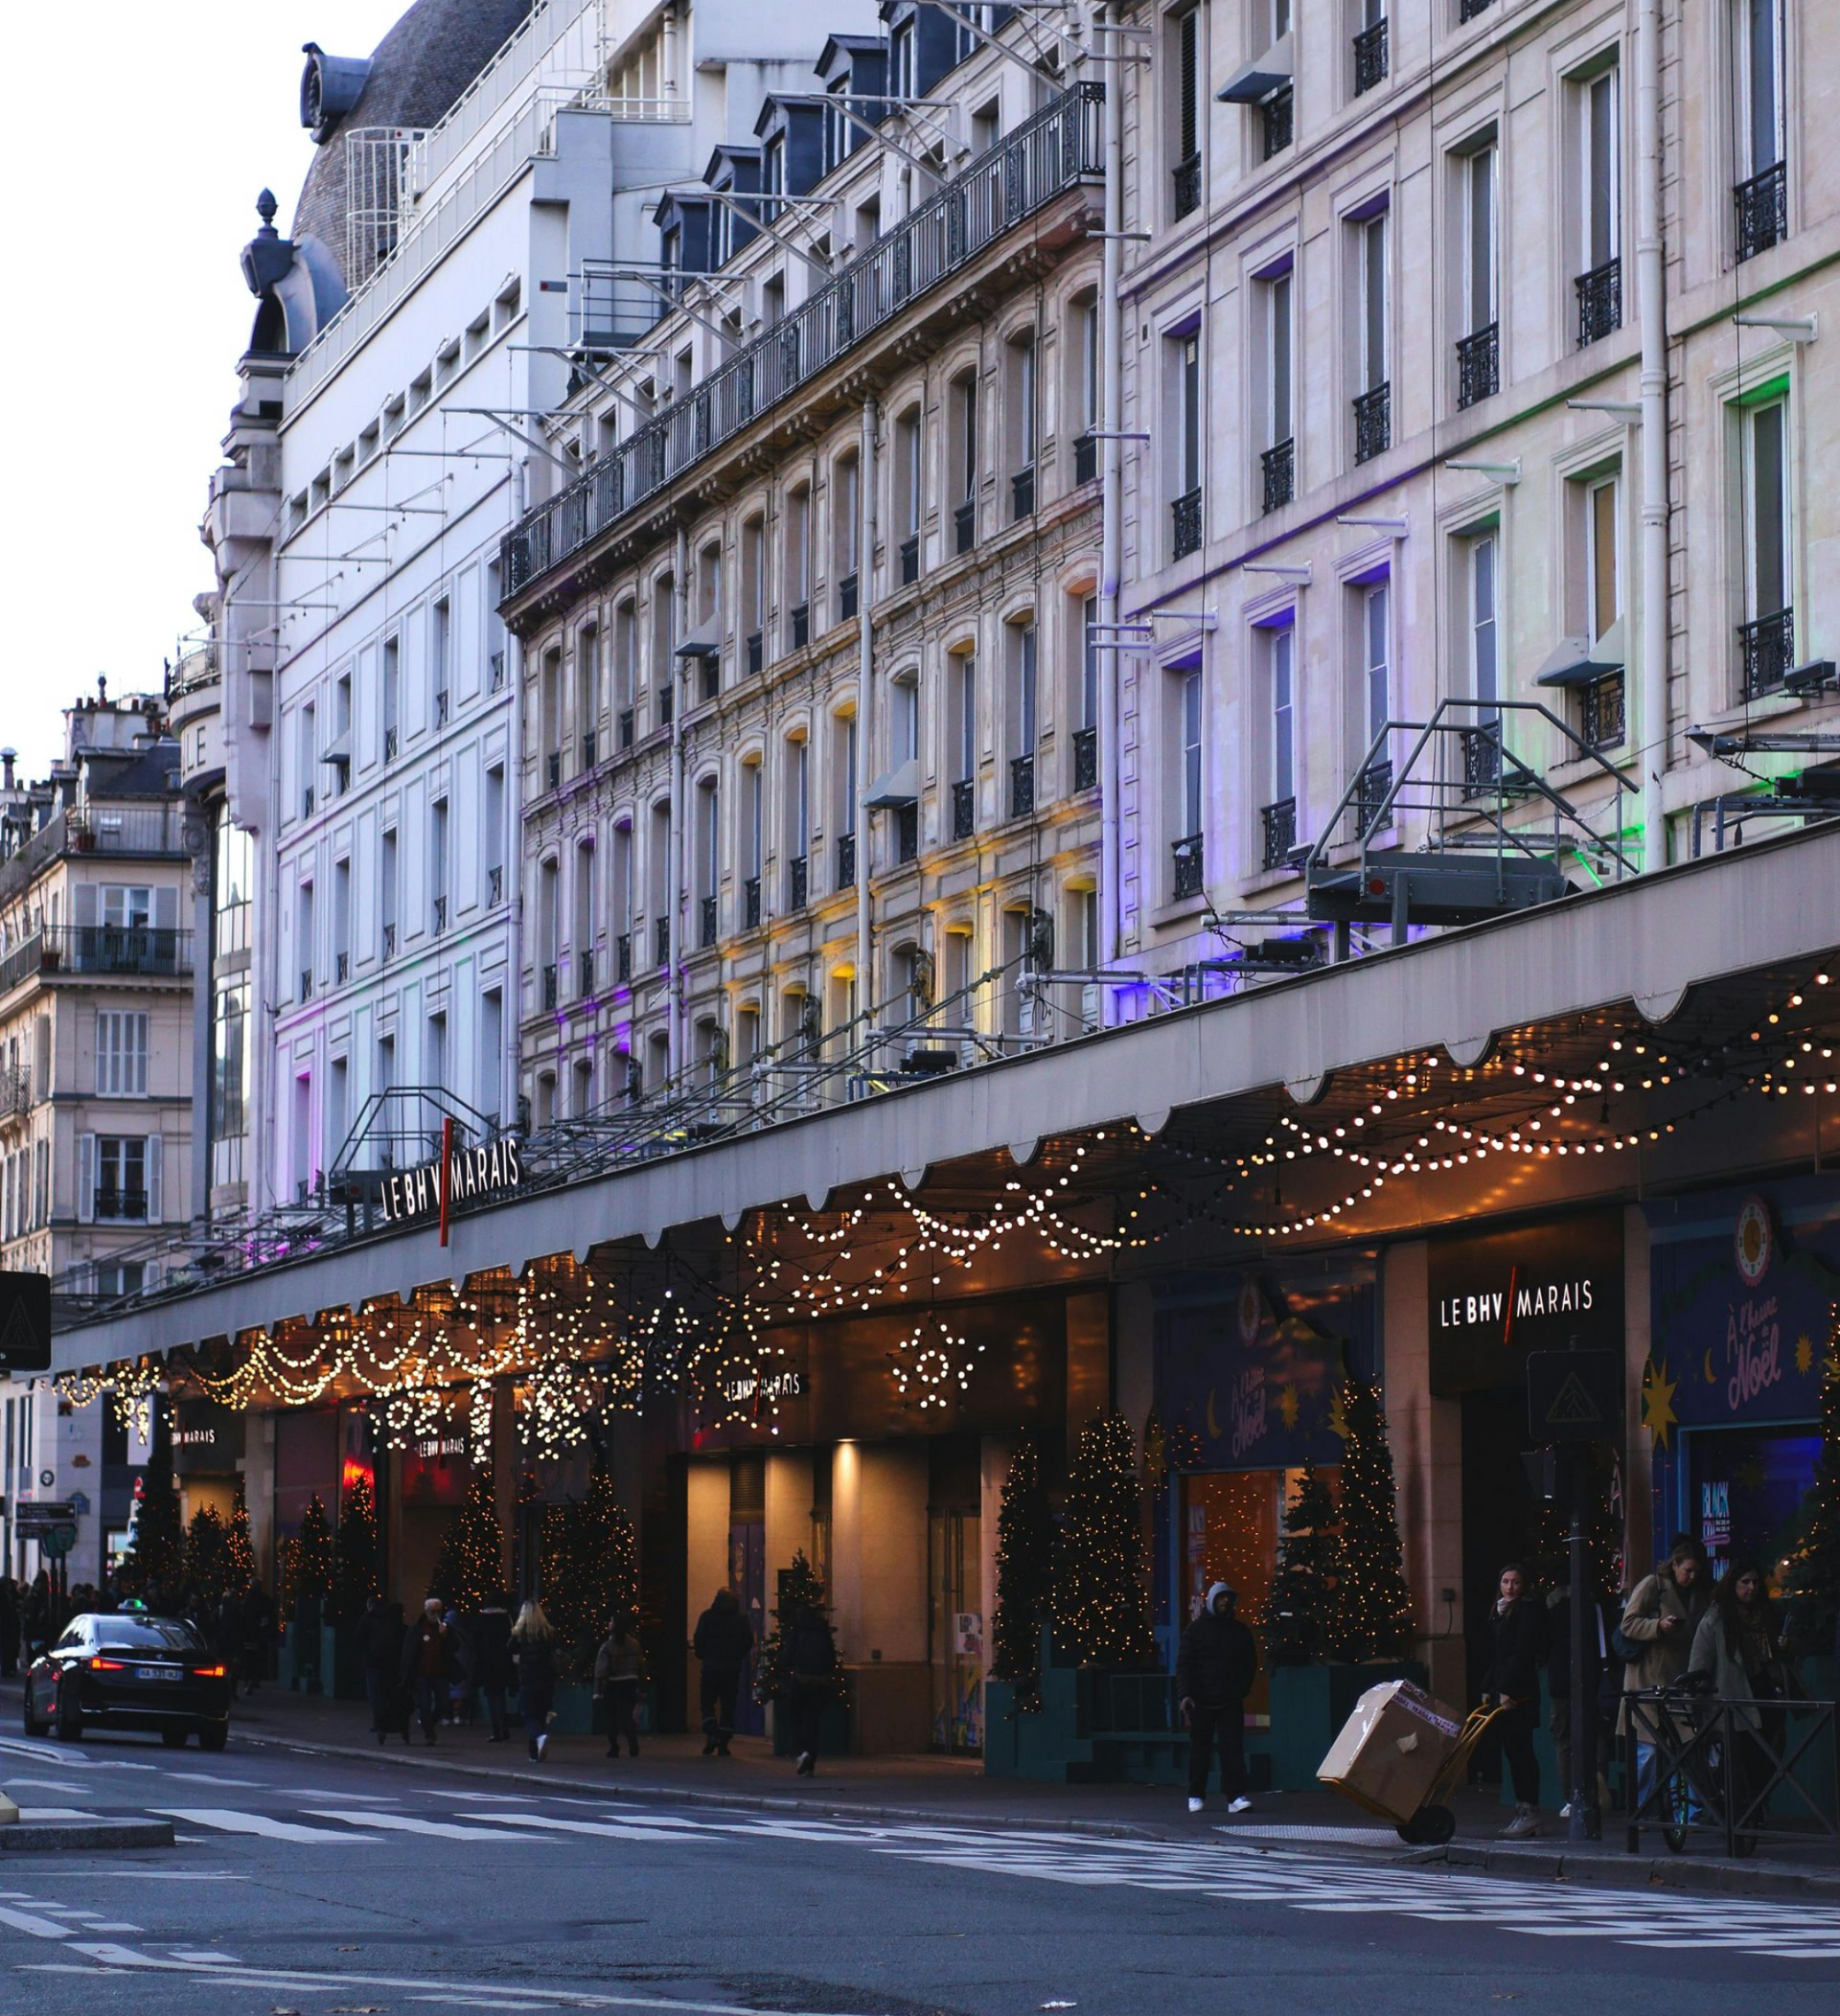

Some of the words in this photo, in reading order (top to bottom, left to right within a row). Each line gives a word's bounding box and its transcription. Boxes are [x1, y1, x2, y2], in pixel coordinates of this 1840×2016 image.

[380, 1176, 402, 1222] LE
[403, 1162, 441, 1217] BHV
[450, 1137, 519, 1203] MARAIS
[1440, 1297, 1462, 1328] LE
[1466, 1292, 1504, 1325] BHV
[1515, 1279, 1594, 1319] MARAIS
[1726, 1303, 1738, 1364] À
[759, 1372, 800, 1399] MARAIS
[1727, 1322, 1782, 1411] Noël
[183, 1428, 216, 1445] MARAIS
[1701, 1480, 1730, 1519] BLACK
